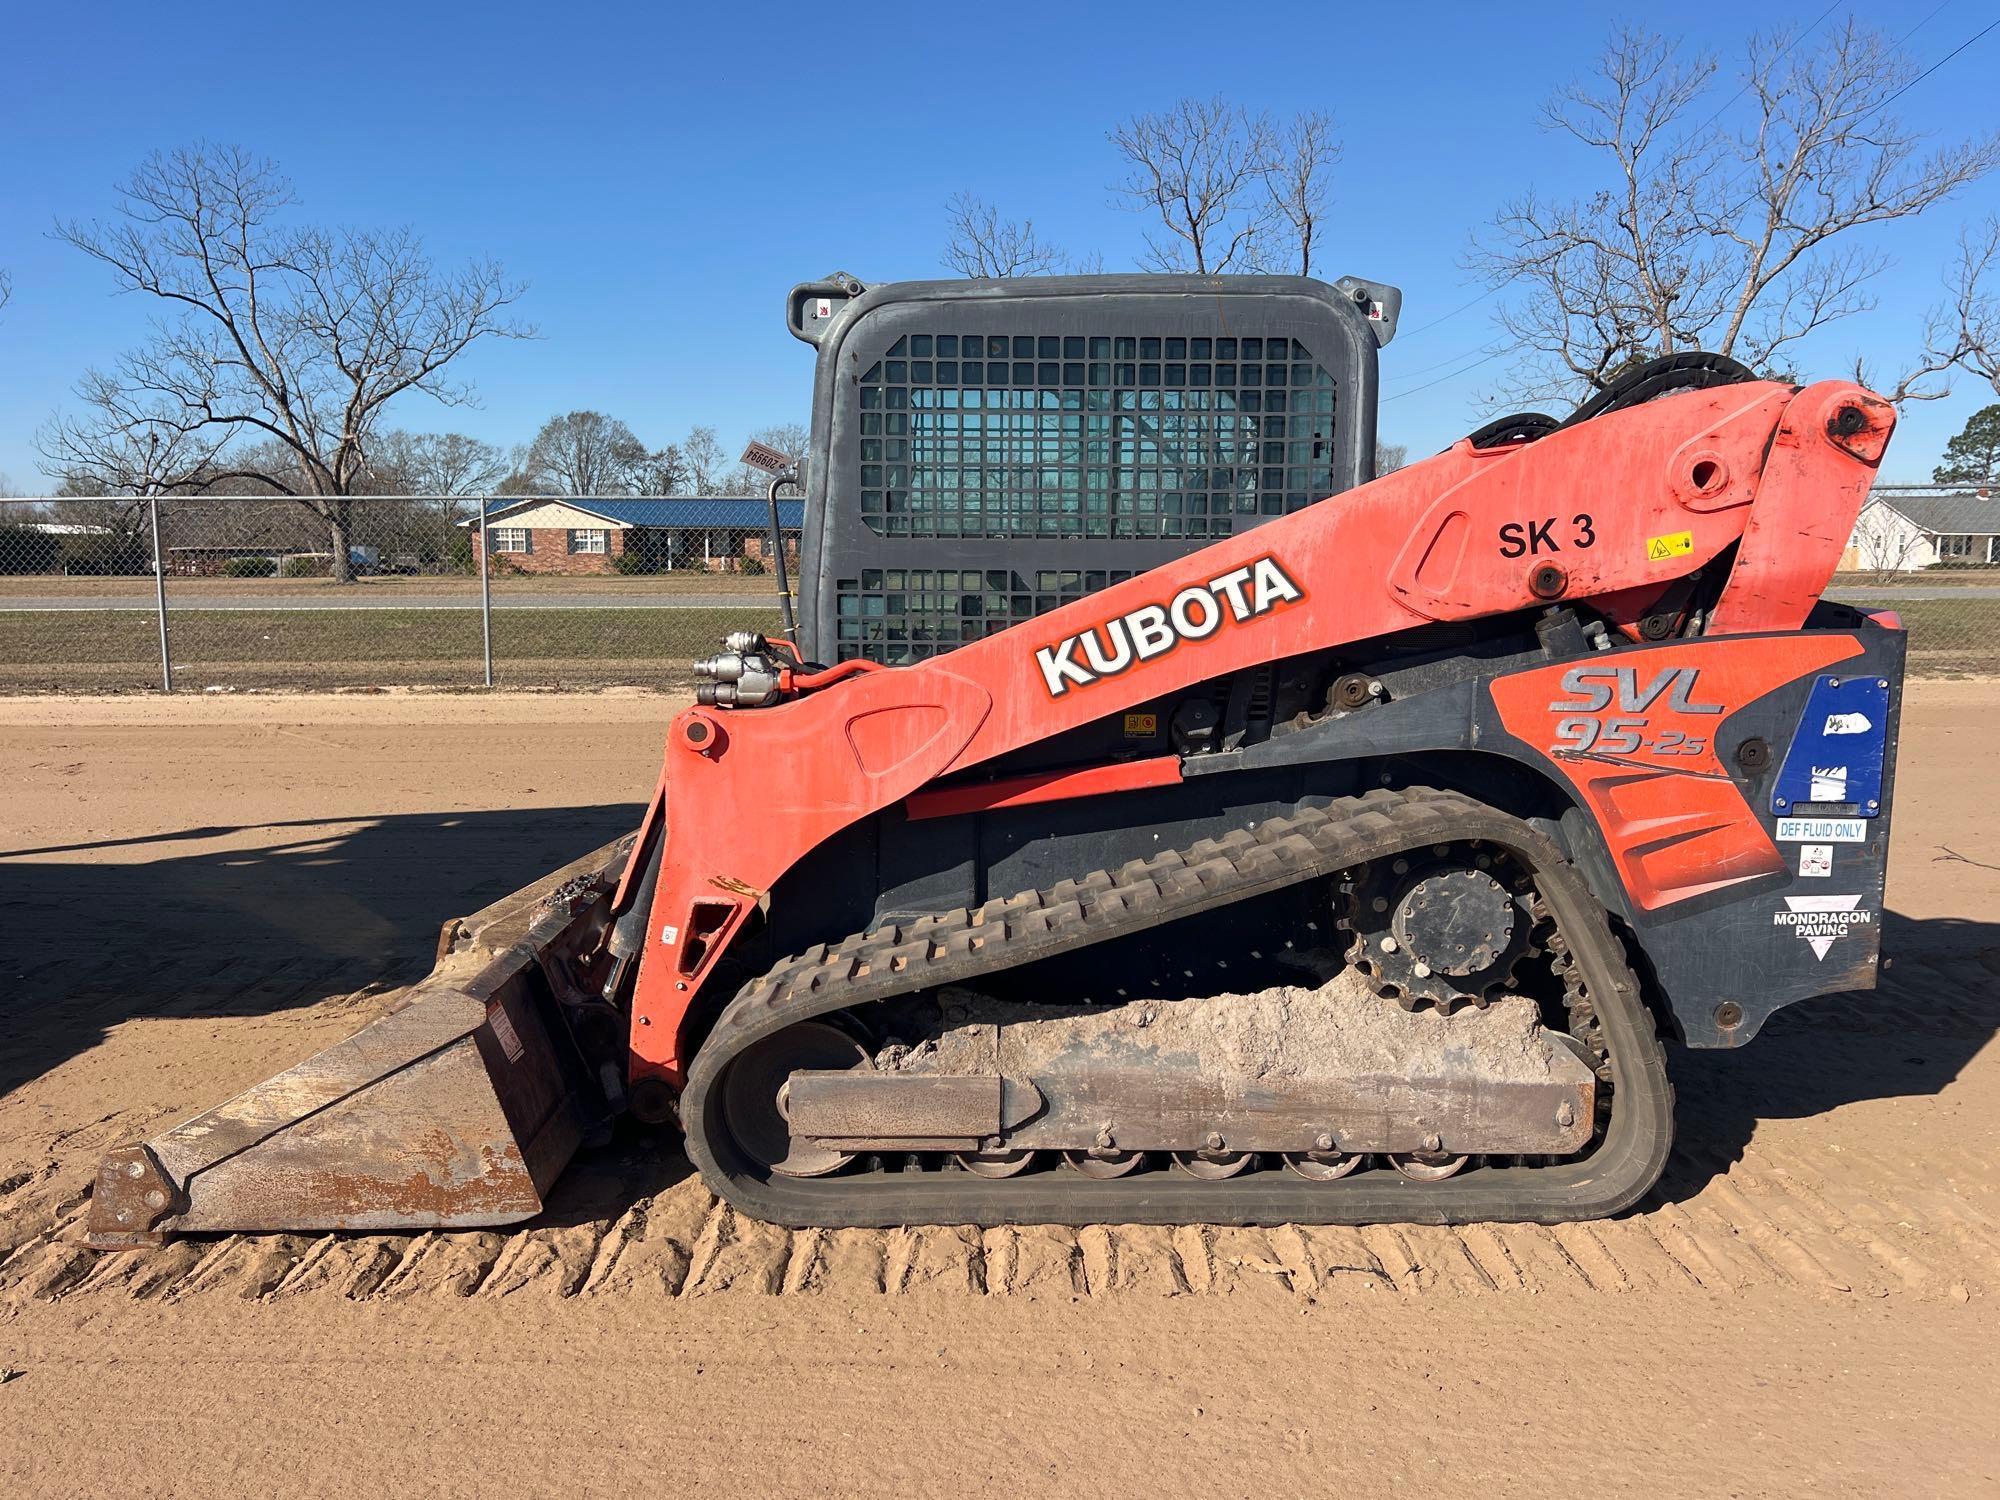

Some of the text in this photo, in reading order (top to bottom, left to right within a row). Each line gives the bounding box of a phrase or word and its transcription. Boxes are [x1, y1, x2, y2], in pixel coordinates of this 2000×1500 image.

[747, 450, 779, 469] 209994
[1499, 514, 1596, 558] SK 3
[1035, 557, 1303, 697] KUBOTA
[1548, 666, 1725, 714] SVL
[1781, 822, 1862, 838] DEF FLUID ONLY
[1774, 911, 1871, 925] MONDRAGON
[1796, 924, 1848, 936] PAVING
